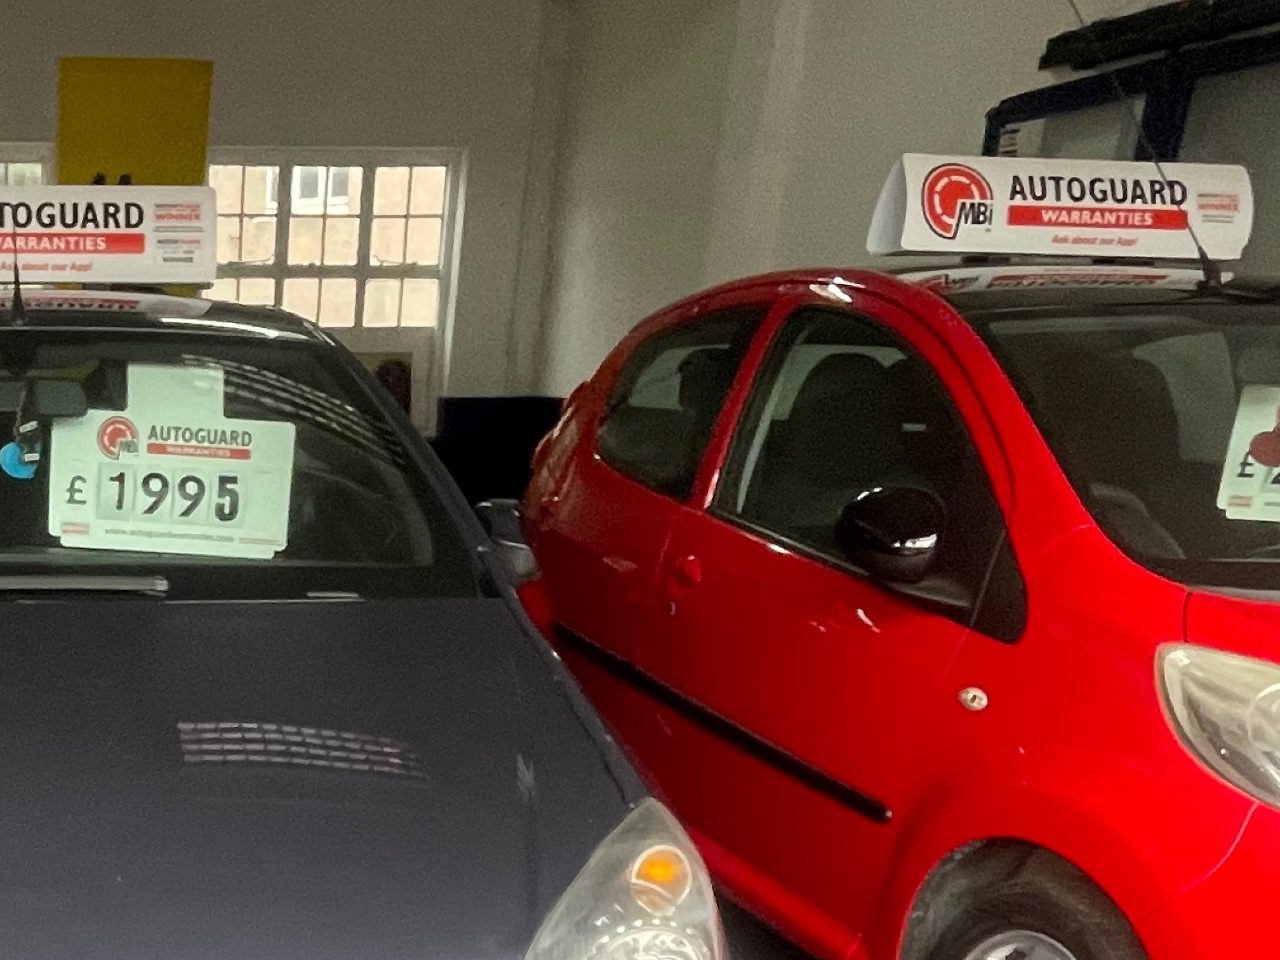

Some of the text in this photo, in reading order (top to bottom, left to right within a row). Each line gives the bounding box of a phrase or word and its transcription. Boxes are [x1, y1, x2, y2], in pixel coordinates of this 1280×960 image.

[1009, 176, 1187, 206] AUTOGUARD
[959, 200, 994, 226] MBi
[1041, 210, 1153, 227] WARRANTIES
[148, 425, 253, 447] AUTOGUARD
[66, 471, 240, 522] £ 1995
